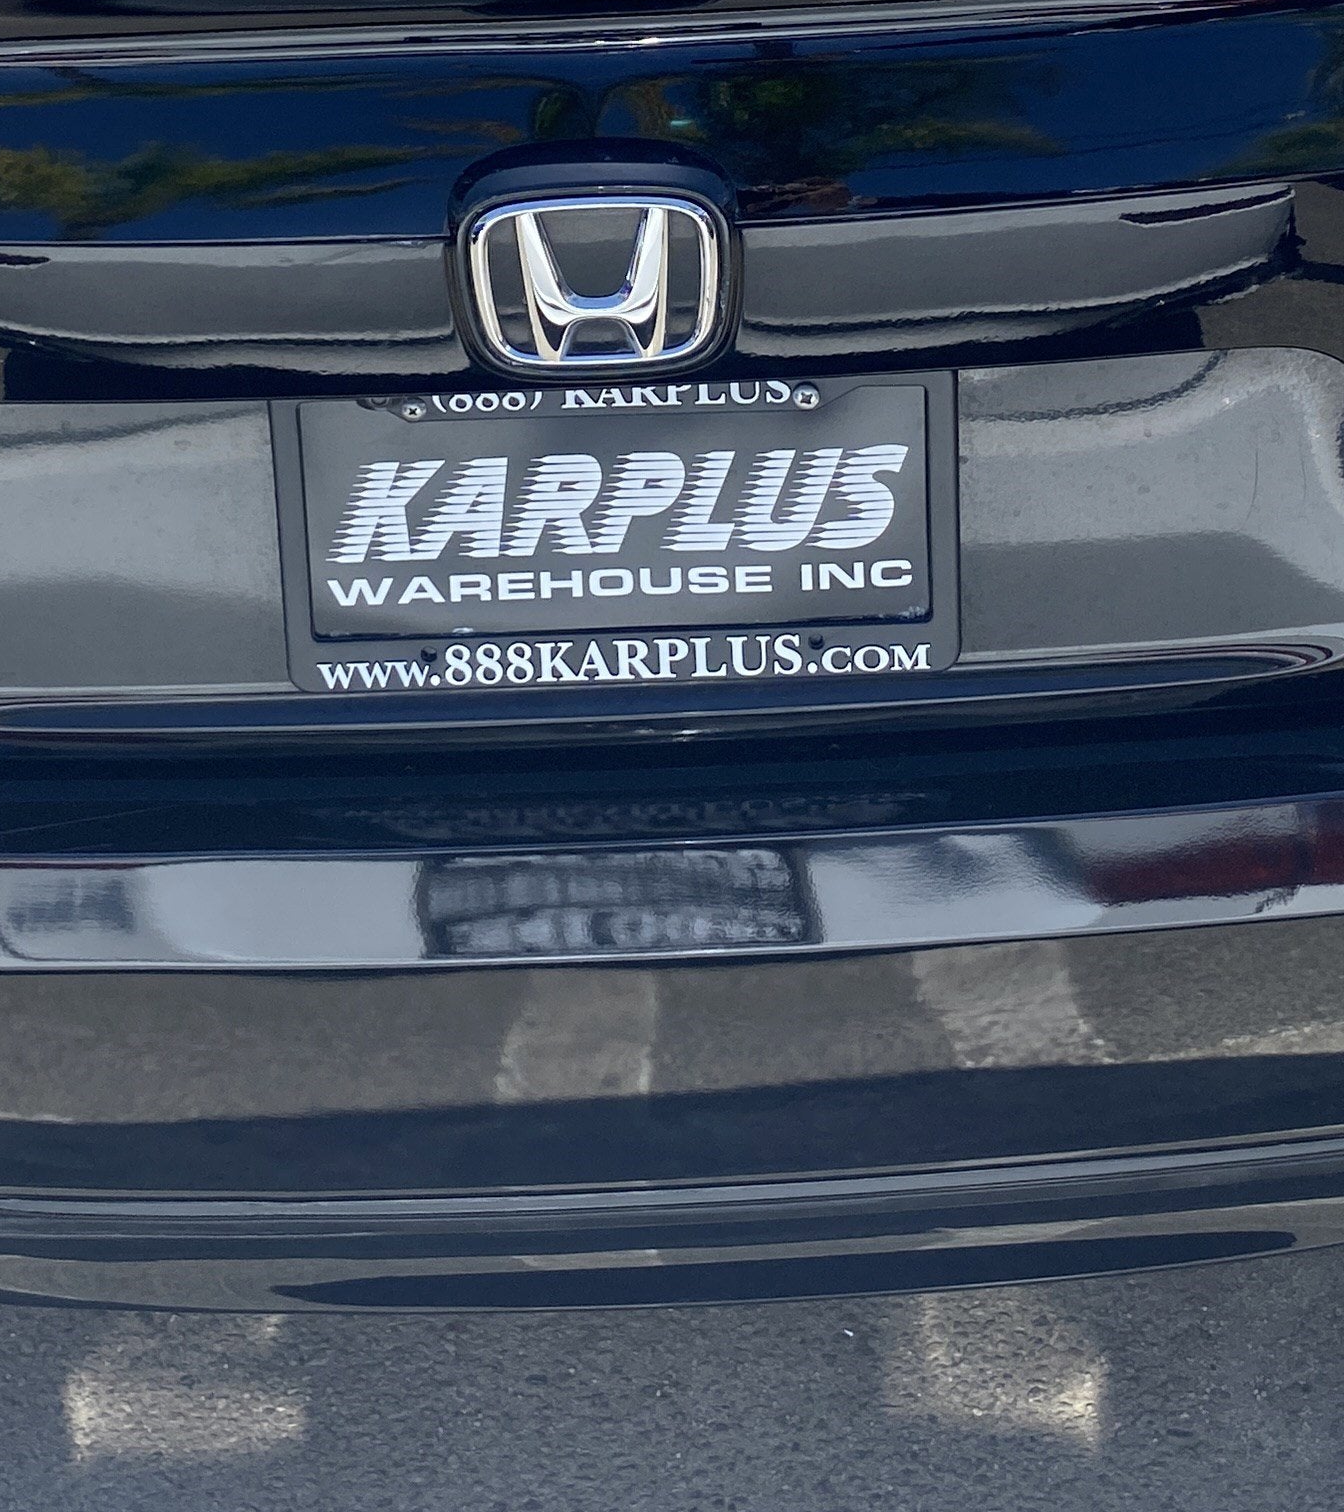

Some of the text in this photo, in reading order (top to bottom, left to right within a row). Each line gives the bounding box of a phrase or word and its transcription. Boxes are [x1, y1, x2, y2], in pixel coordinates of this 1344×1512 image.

[325, 444, 910, 564] KARPLUS
[327, 559, 914, 607] WAREHOUSE INC
